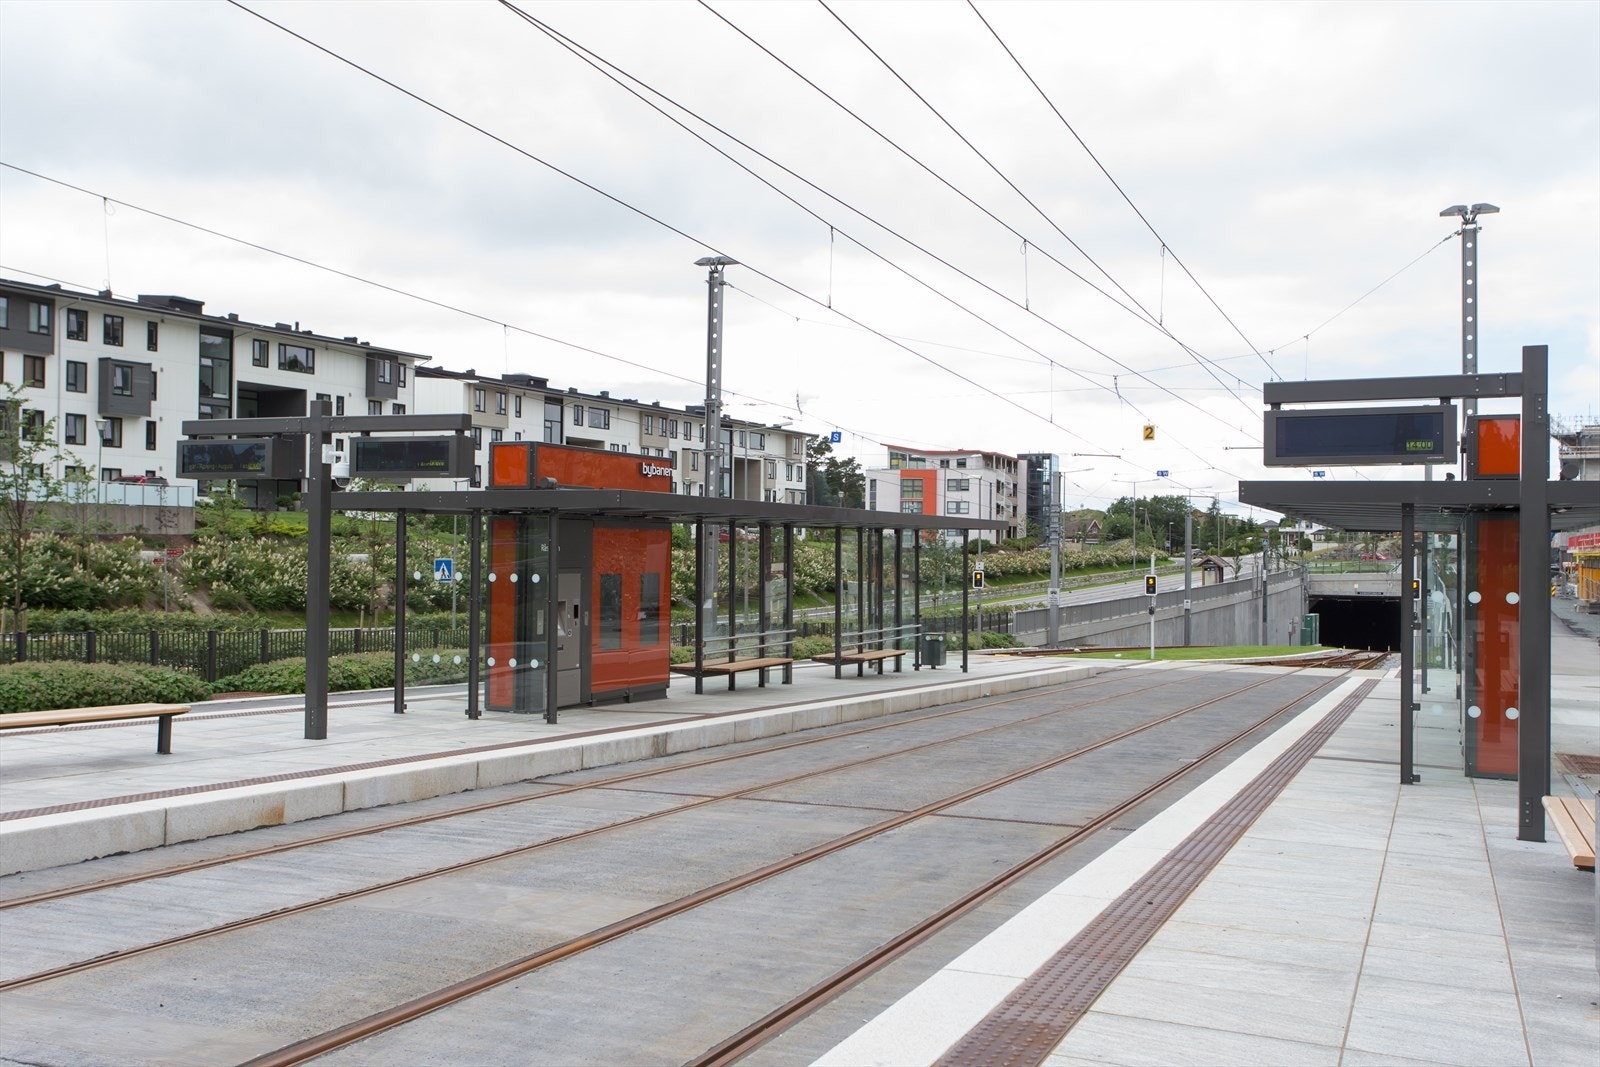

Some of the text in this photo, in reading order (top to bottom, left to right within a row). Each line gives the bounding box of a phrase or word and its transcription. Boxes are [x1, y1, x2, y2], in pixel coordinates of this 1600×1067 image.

[833, 433, 839, 442] S
[1145, 426, 1154, 439] 2
[642, 462, 672, 477] bybanen
